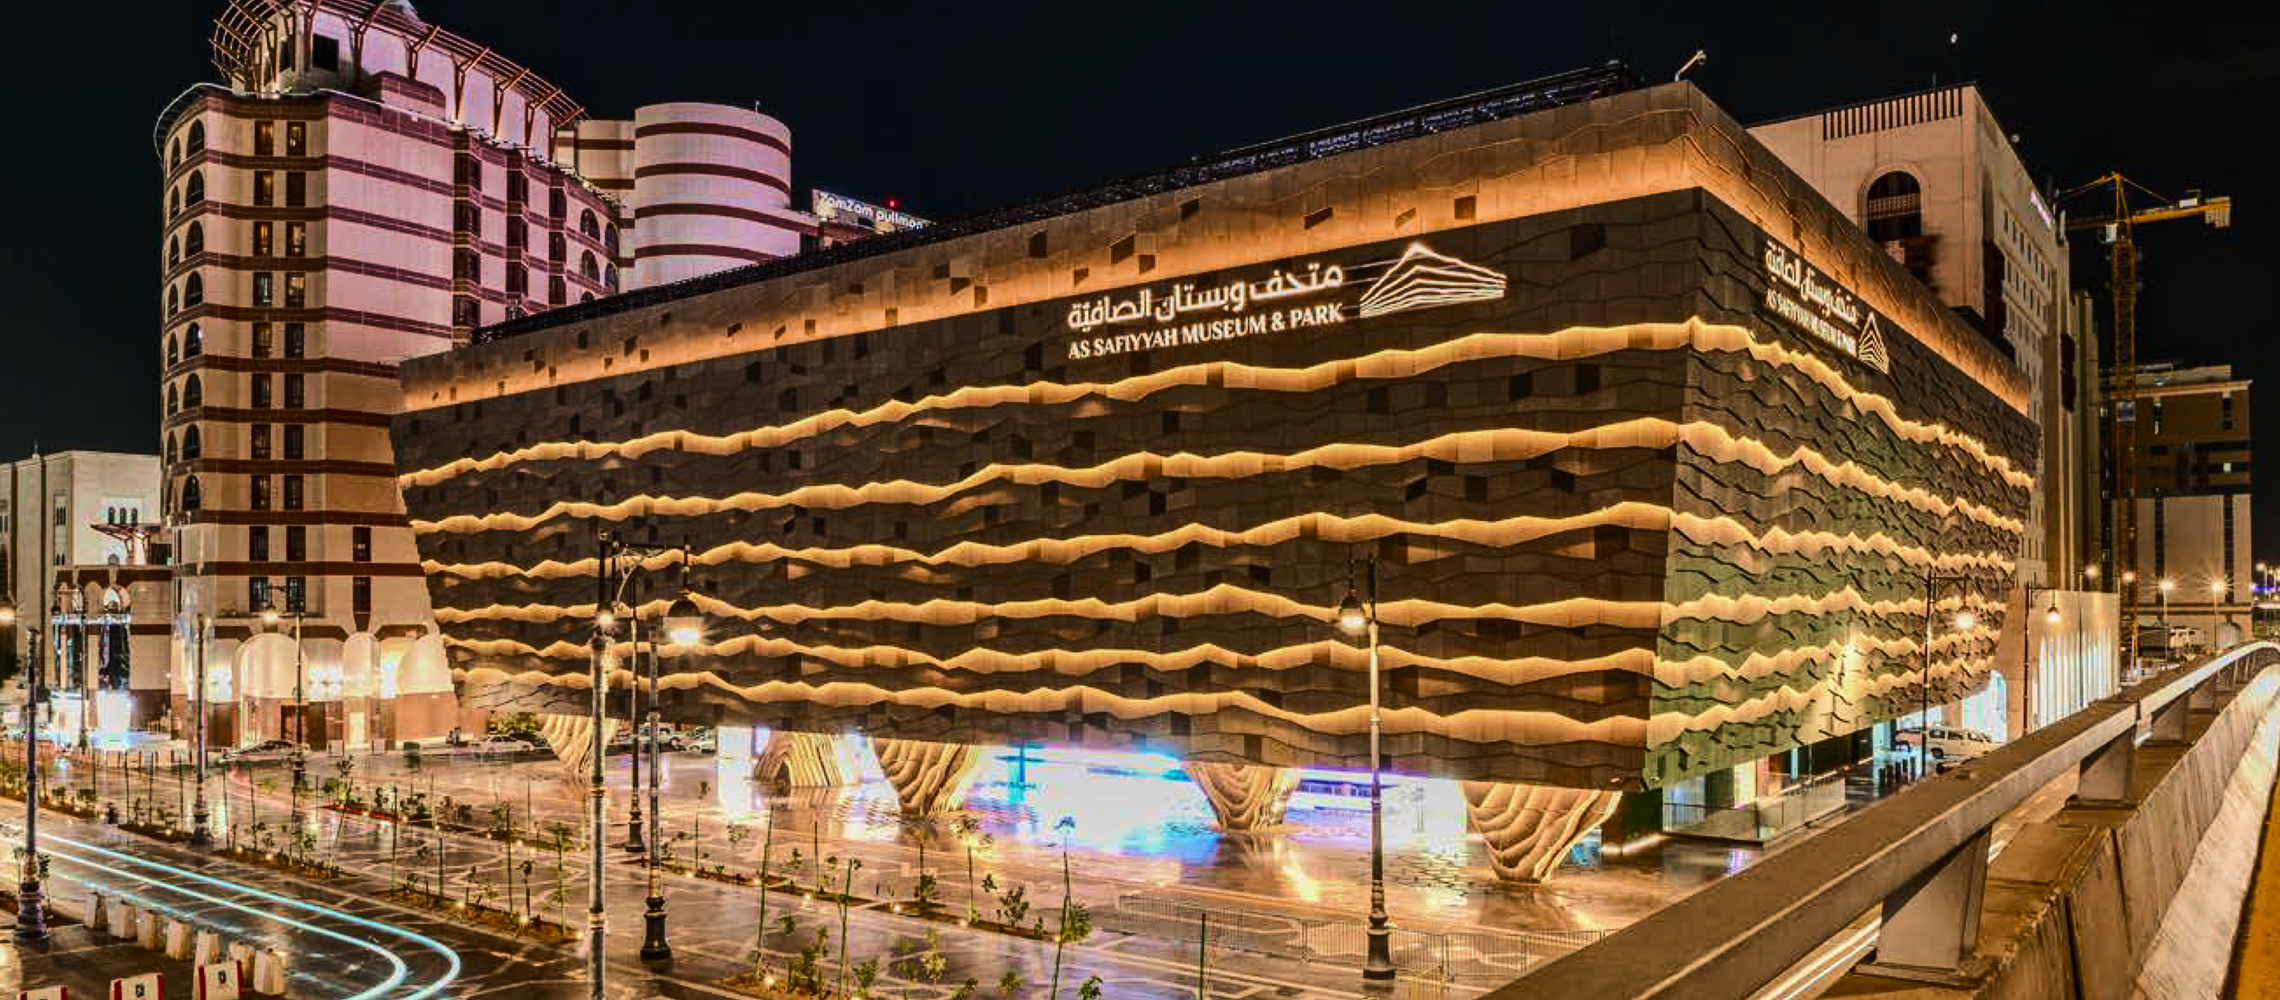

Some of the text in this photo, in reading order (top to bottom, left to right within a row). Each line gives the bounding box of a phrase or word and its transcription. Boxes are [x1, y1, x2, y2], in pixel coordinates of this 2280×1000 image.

[1155, 280, 1246, 321] وبستان
[1248, 262, 1343, 300] متحف
[1068, 302, 1344, 359] AS SAFIYYAH MUSEUM & PARK
